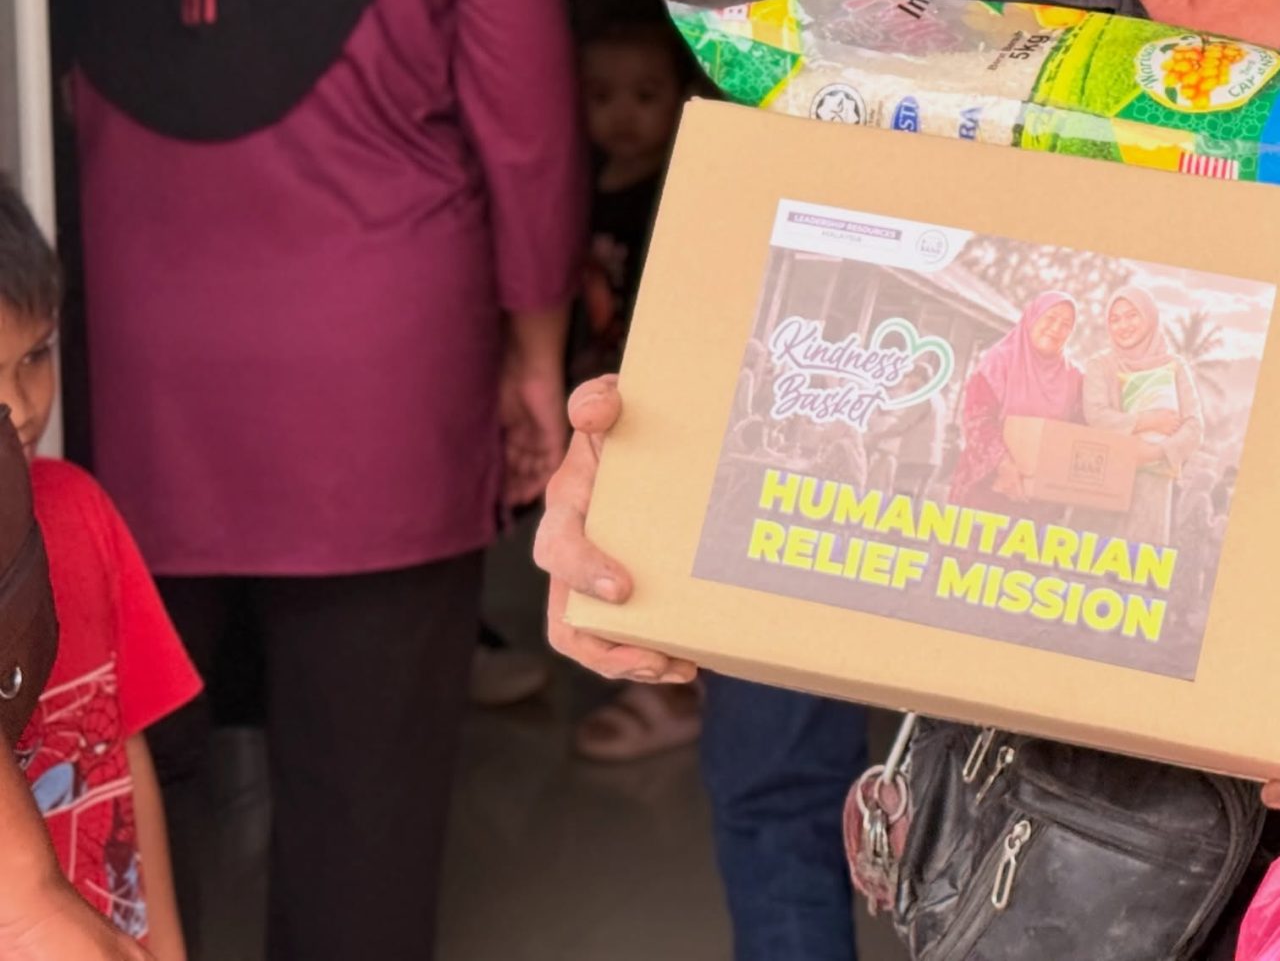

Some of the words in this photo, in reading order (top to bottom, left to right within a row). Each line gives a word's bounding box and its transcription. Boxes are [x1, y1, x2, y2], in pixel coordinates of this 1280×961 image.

[1008, 34, 1051, 60] 5kg
[771, 318, 911, 384] Kindness
[772, 372, 886, 428] Basket
[758, 469, 1178, 590] HUMANITARIAN
[746, 519, 929, 590] RELIEF
[936, 558, 1168, 642] MISSION
